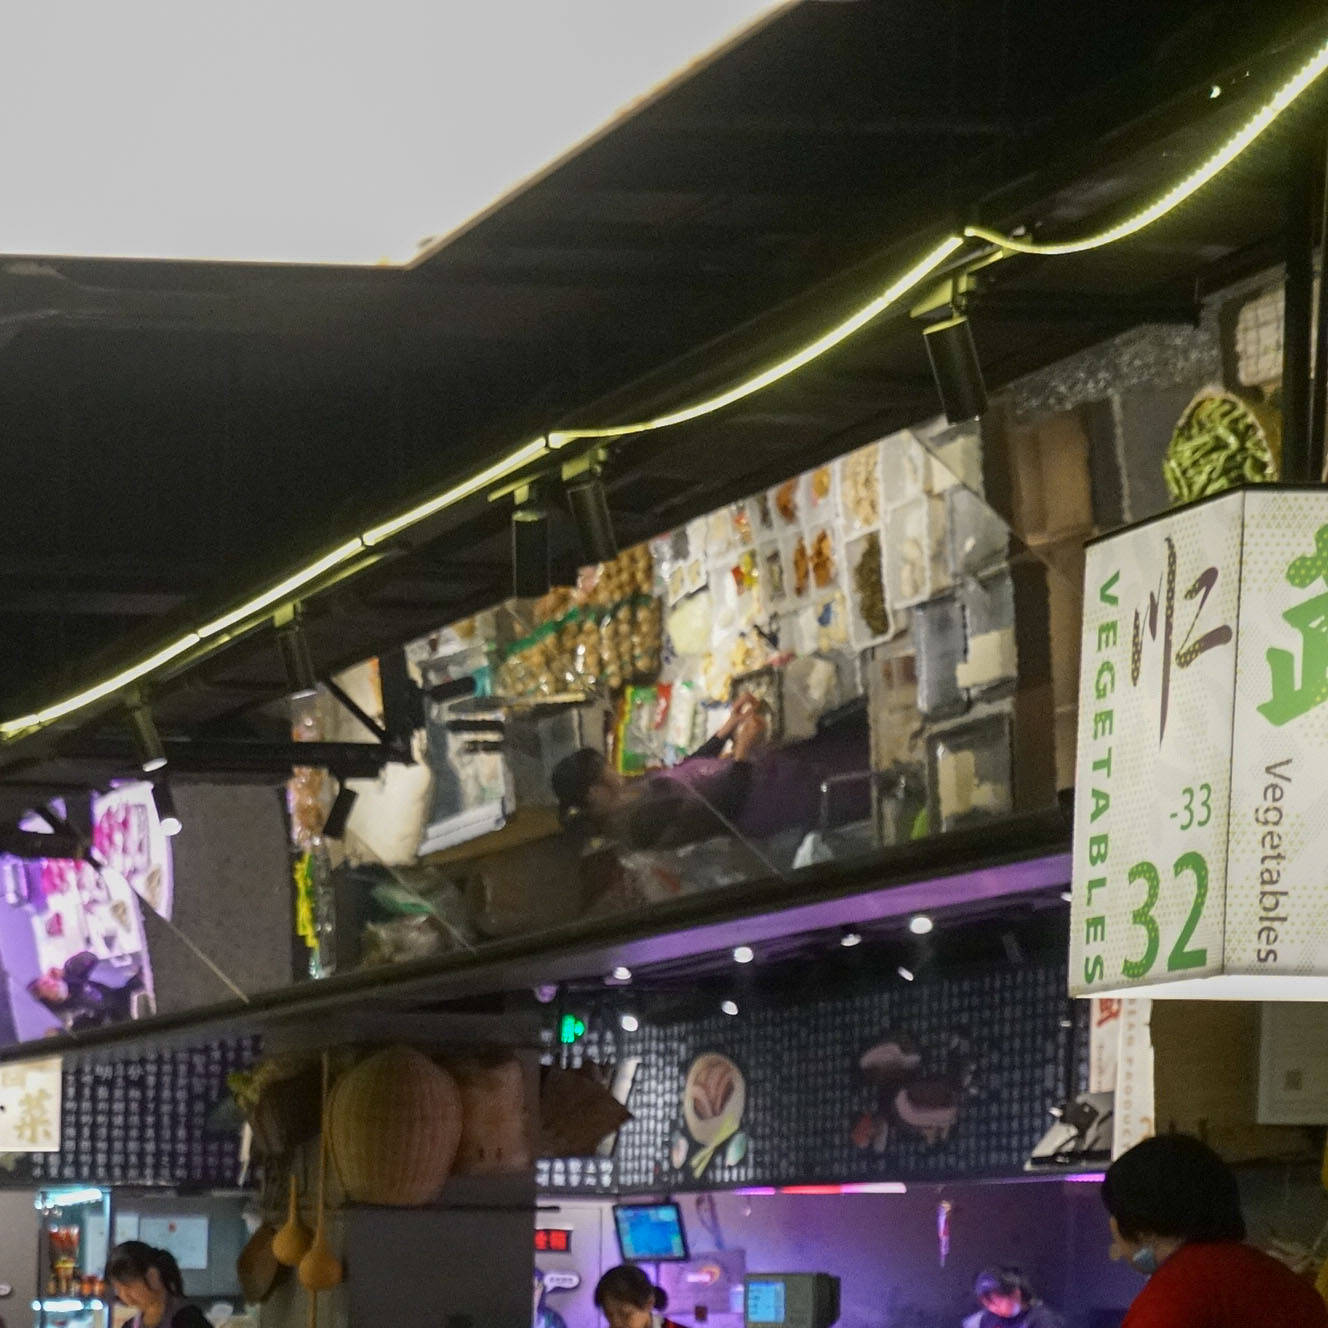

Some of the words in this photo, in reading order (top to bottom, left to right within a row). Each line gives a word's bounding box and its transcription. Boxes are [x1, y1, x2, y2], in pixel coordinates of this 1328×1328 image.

[1084, 570, 1121, 984] VEGETABLES
[1169, 783, 1212, 831] -33
[1121, 851, 1209, 979] 32
[1255, 758, 1293, 964] Vegetables
